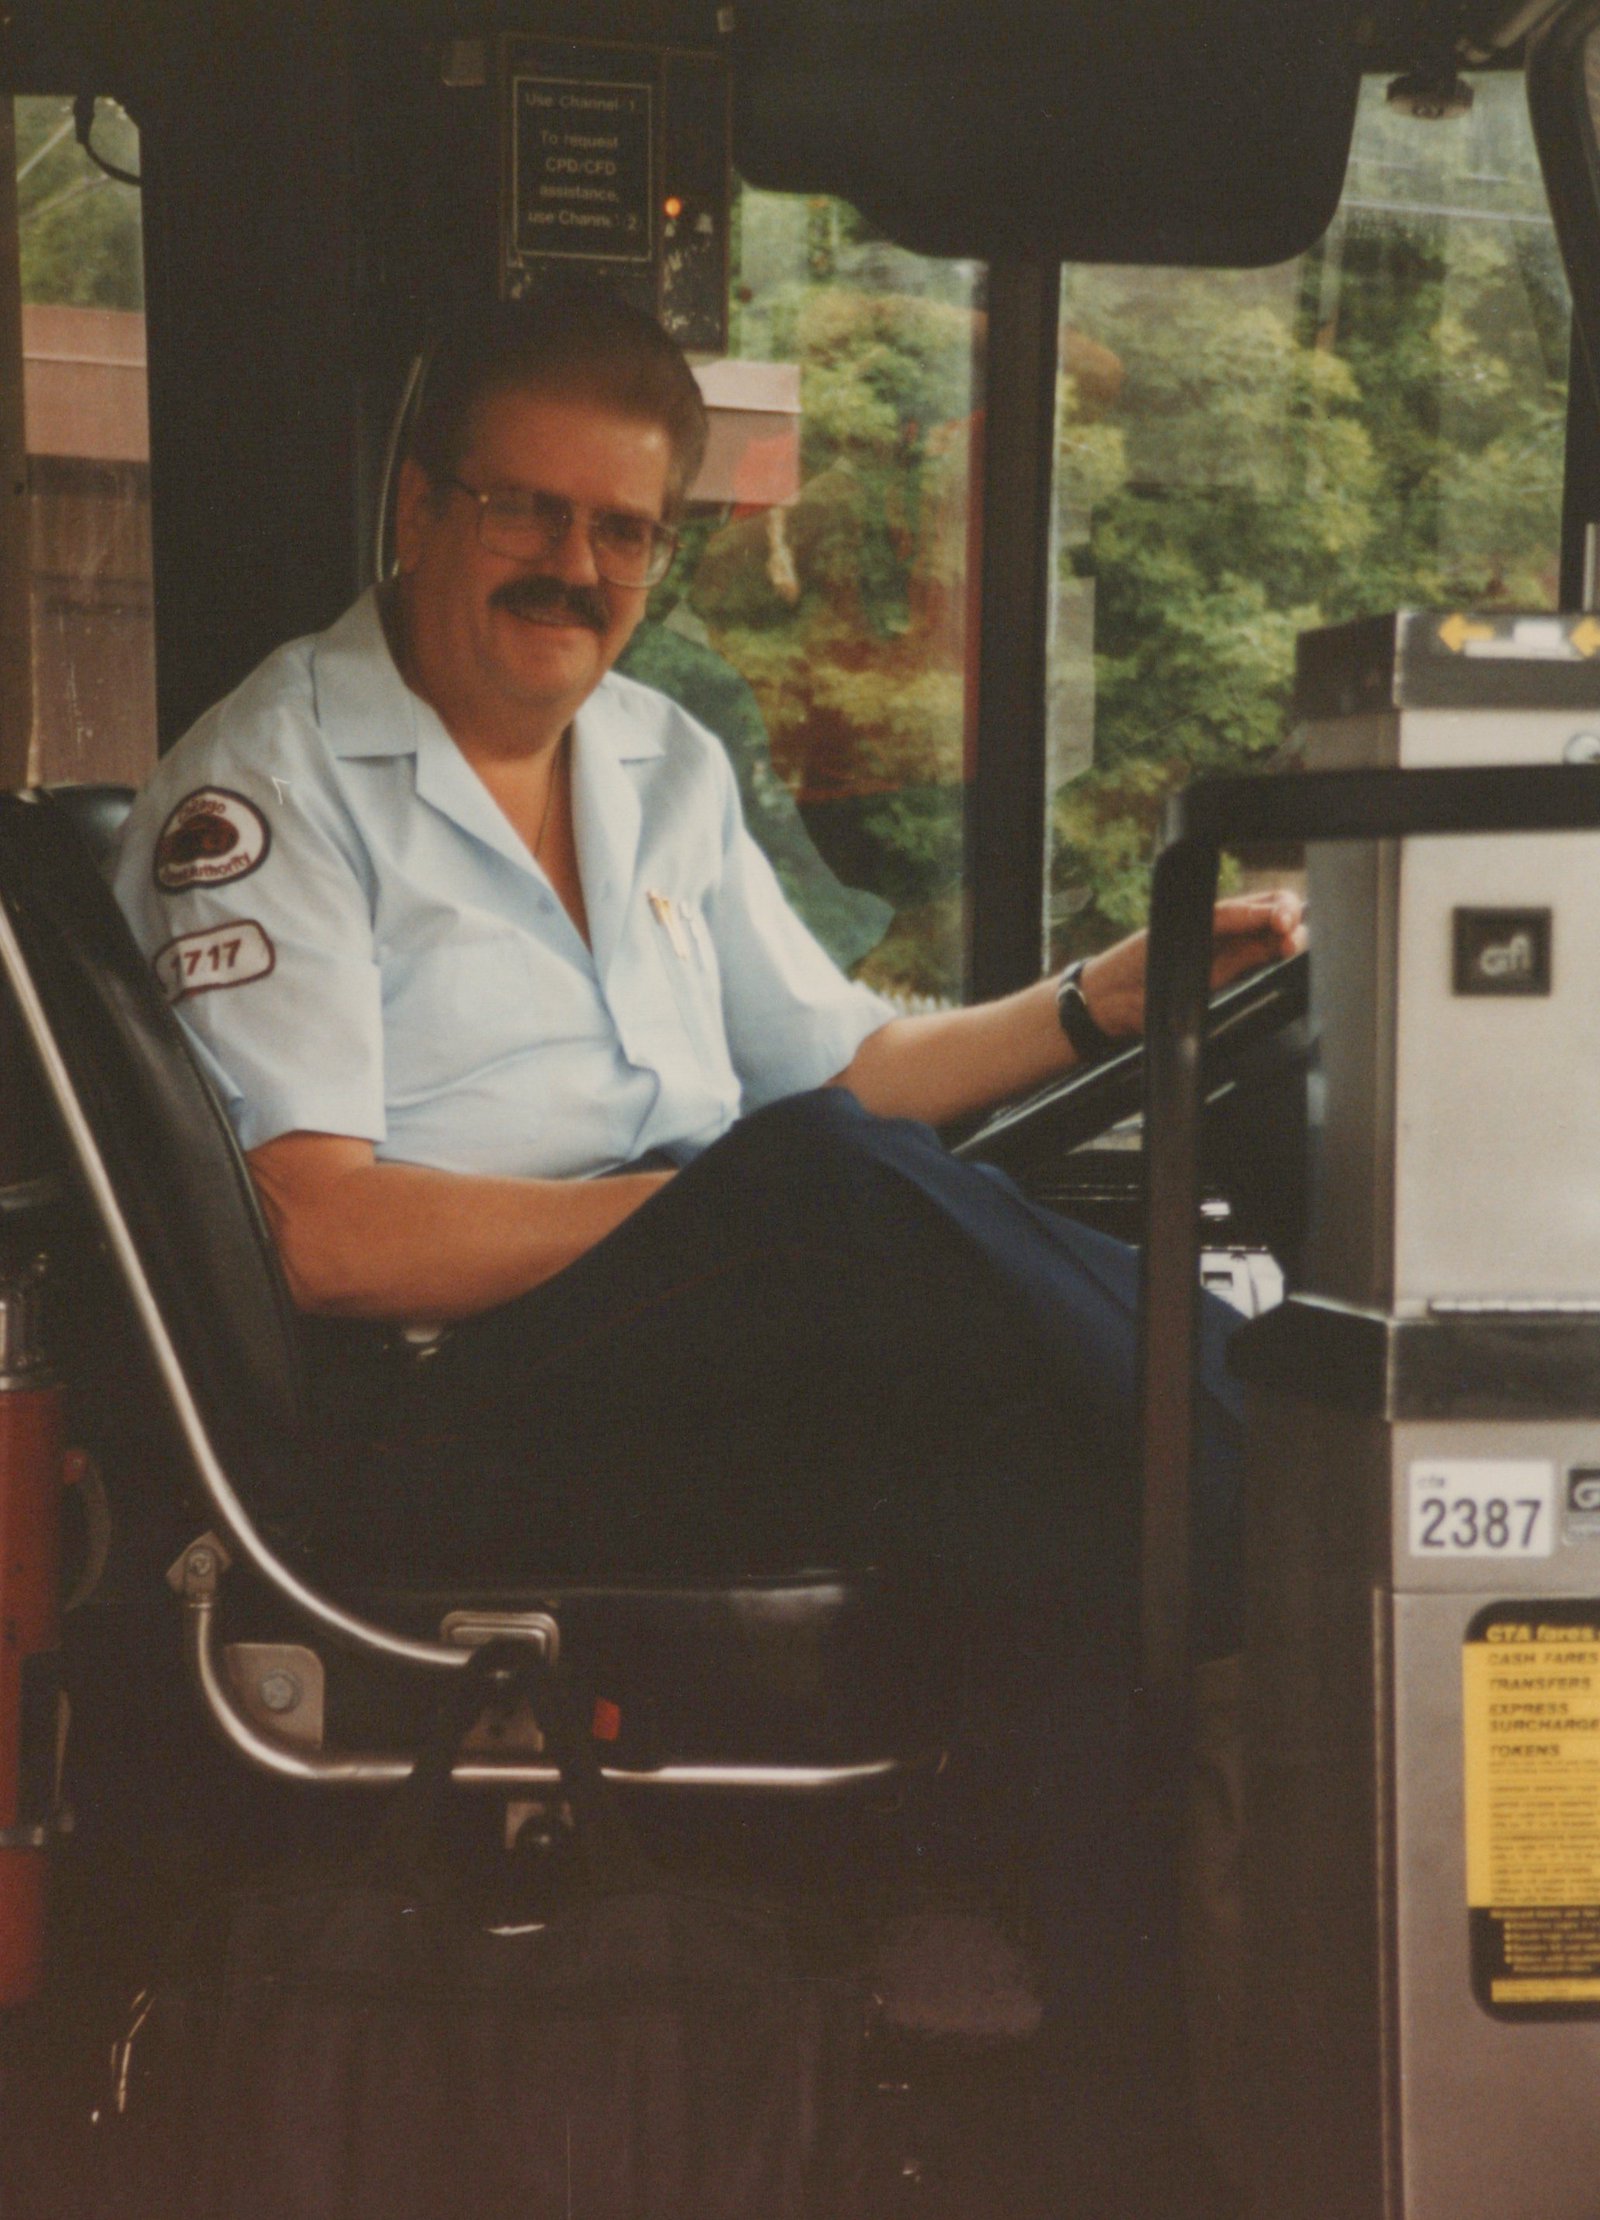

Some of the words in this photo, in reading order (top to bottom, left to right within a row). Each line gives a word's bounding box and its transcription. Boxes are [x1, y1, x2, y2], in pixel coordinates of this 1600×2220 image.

[525, 92, 554, 108] Use
[559, 94, 619, 112] Channel
[628, 99, 636, 113] 1
[539, 128, 559, 146] To
[563, 132, 619, 151] request
[545, 156, 617, 177] CPD/CFD
[626, 212, 638, 231] 2
[1420, 1497, 1542, 1548] 2387
[1486, 1623, 1531, 1643] CTA
[1488, 1652, 1536, 1665] CASH
[1489, 1676, 1592, 1691] TRANSFERS
[1489, 1703, 1569, 1717] EXPRESS
[1490, 1744, 1561, 1758] TOKENS
